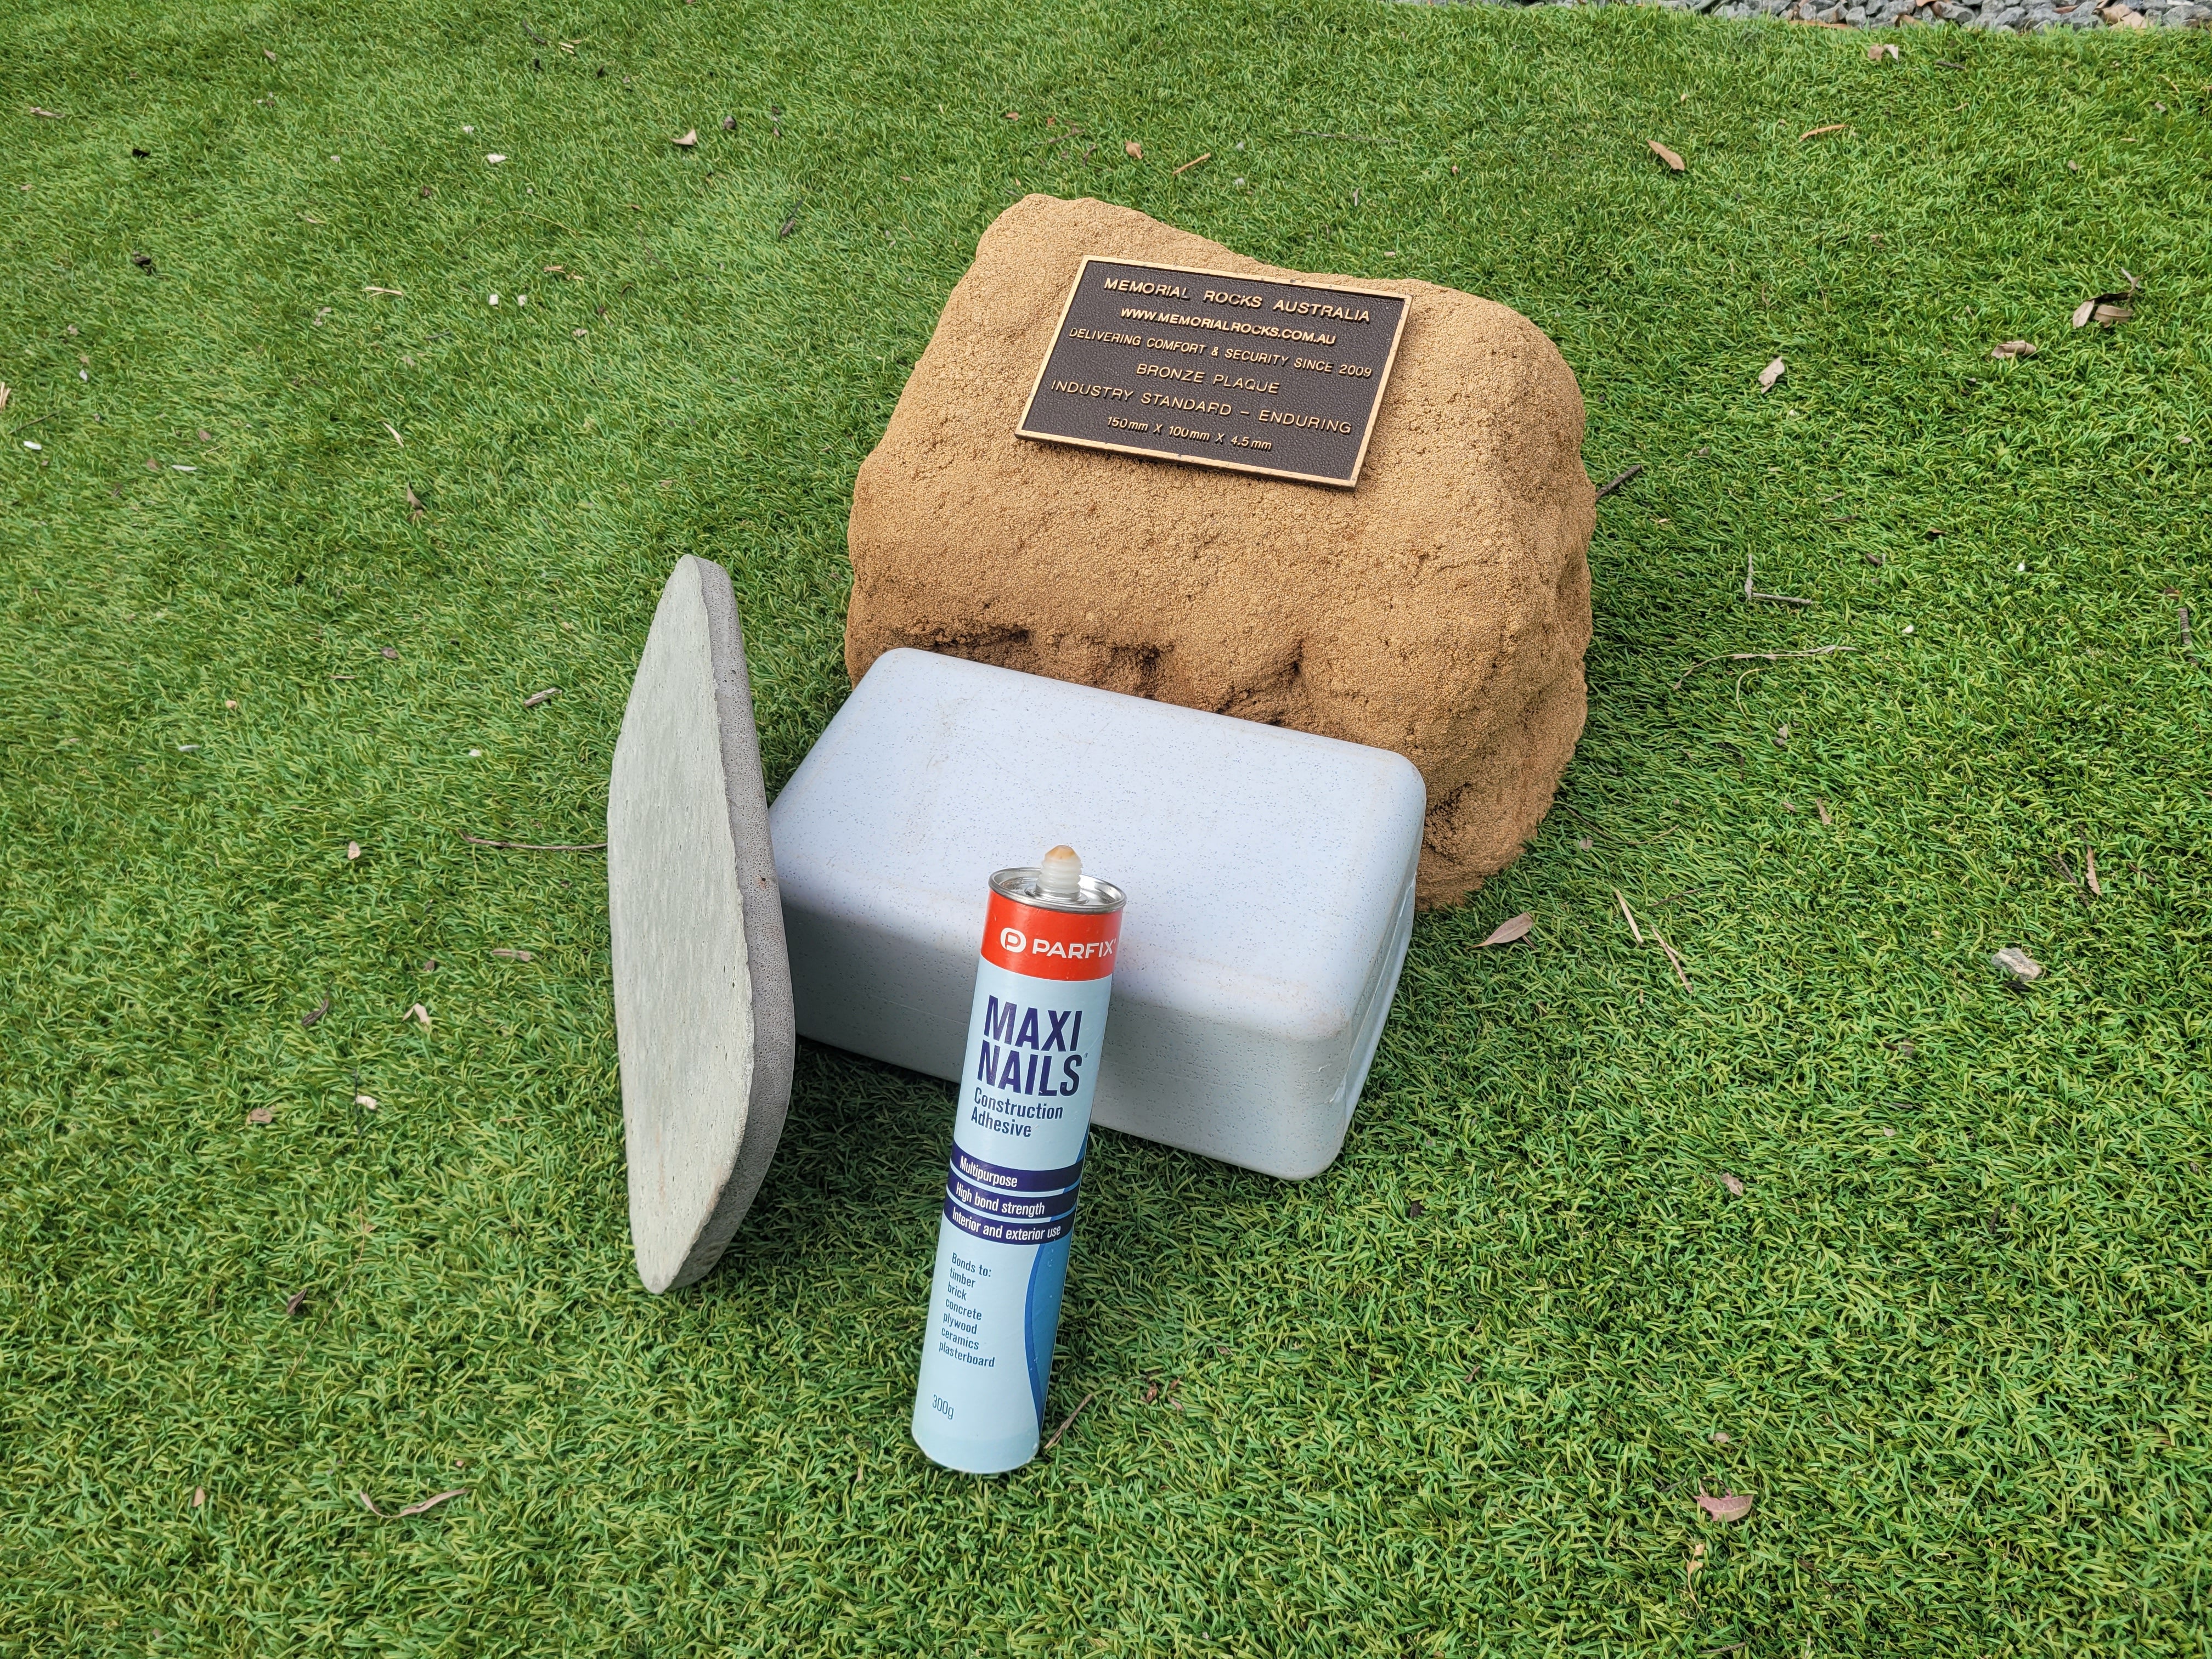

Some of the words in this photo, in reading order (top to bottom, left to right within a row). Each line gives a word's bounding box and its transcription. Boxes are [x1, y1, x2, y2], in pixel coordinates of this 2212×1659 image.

[1104, 278, 1189, 300] MEMORIAL
[1203, 290, 1262, 308] ROCKS
[1273, 300, 1369, 322] AUSTRALIA
[1120, 307, 1336, 346] WWW.MEMORIALROCKS.COM.AU
[1069, 328, 1141, 346] DELIVERING
[1147, 338, 1206, 356] COMFORT
[1211, 346, 1219, 357] &
[1225, 347, 1289, 366] SECURITY
[1294, 357, 1335, 373] SINCE
[1340, 364, 1372, 378] 2009
[1137, 364, 1205, 383] BRONZE
[1213, 374, 1280, 394] PLAQUE
[1051, 380, 1133, 401] INDUSTRY
[1141, 392, 1232, 416] STANDARD
[1259, 409, 1352, 433] ENDURING
[1153, 423, 1163, 433] X
[1216, 433, 1224, 443] X
[1032, 939, 1114, 959] PARFIX
[984, 995, 1082, 1052] MAXI
[977, 1040, 1082, 1097] NAILS
[974, 1087, 1063, 1119] Construction
[971, 1110, 1031, 1138] Adhesive
[960, 1155, 1017, 1187] Multipurpose
[956, 1182, 972, 1203] High
[974, 1195, 998, 1211] bond
[1002, 1201, 1045, 1218] strength
[952, 1207, 981, 1232] Interior
[983, 1223, 1002, 1238] and
[1006, 1226, 1045, 1240] exterior
[1047, 1224, 1061, 1238] use
[949, 1267, 975, 1288] timber
[951, 1252, 976, 1273] Bonds
[979, 1263, 992, 1277] to:
[947, 1282, 967, 1301] brick
[943, 1312, 977, 1334] plywood
[945, 1299, 982, 1320] concrete
[941, 1328, 979, 1350] ceramics
[939, 1341, 995, 1368] plasterboard
[932, 1393, 955, 1420] 300g
